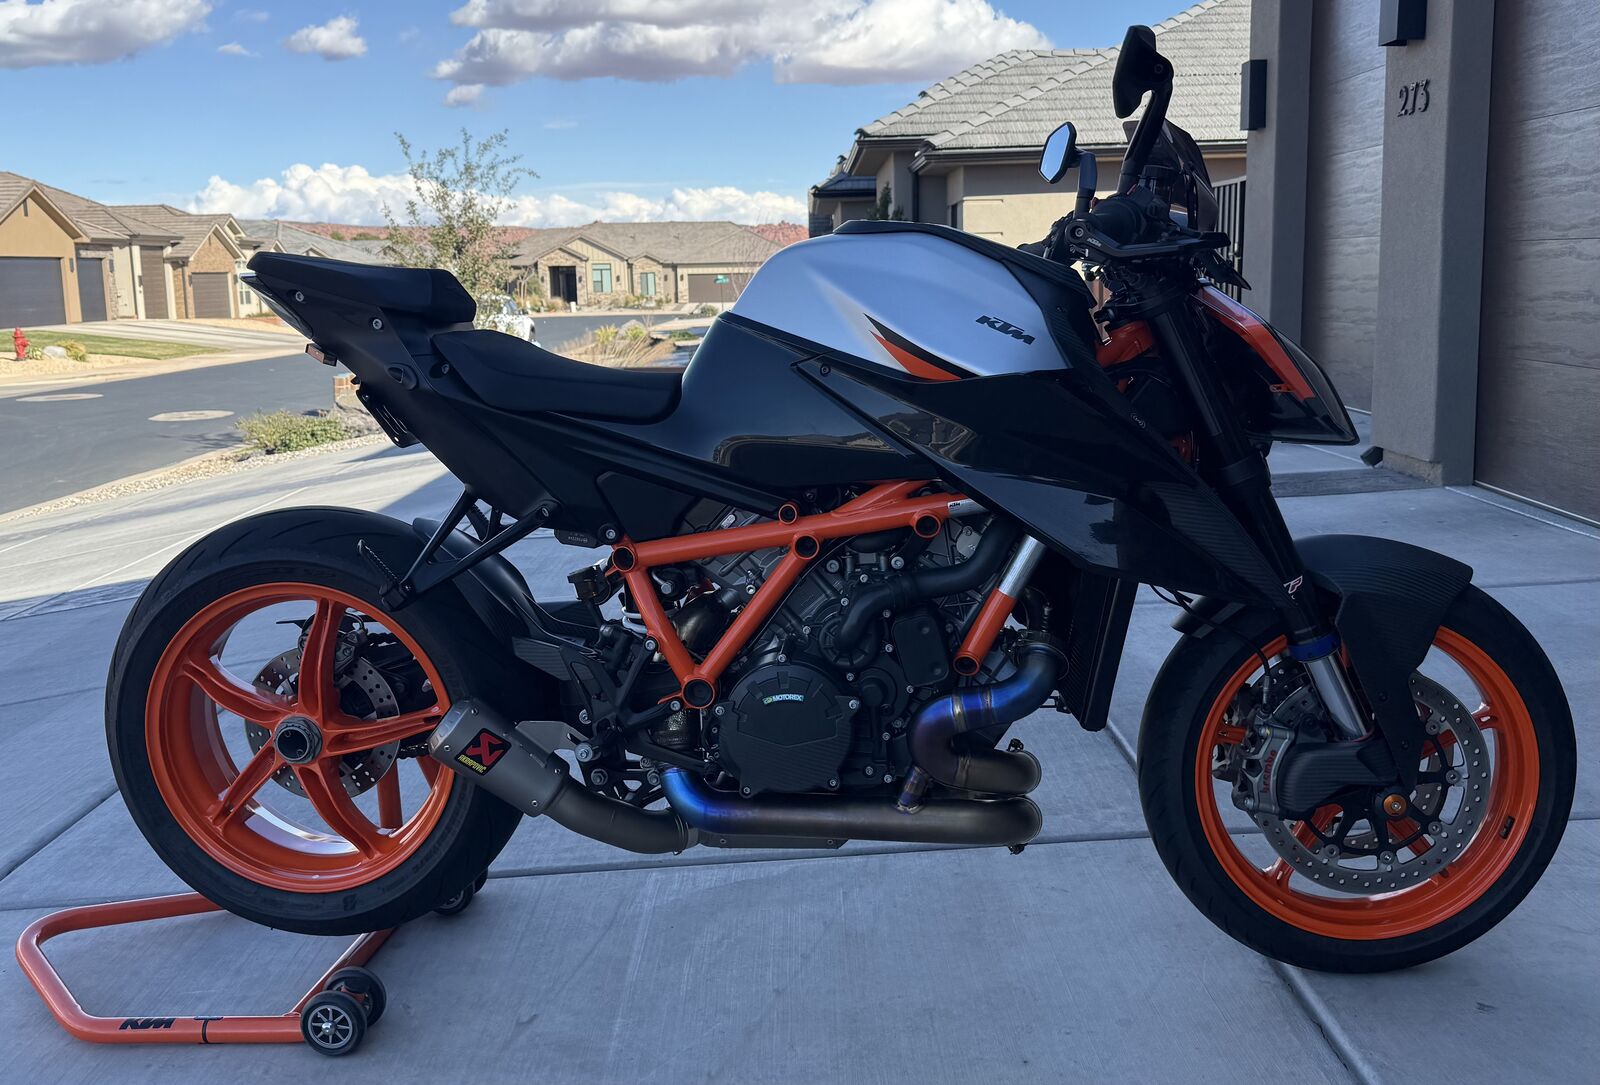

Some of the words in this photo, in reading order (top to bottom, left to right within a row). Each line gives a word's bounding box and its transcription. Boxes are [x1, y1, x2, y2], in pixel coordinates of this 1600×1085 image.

[1397, 78, 1431, 117] 273
[975, 315, 1036, 345] KTM
[772, 693, 804, 702] MOTOREX
[1260, 750, 1277, 794] brembo
[119, 1017, 176, 1031] KTM
